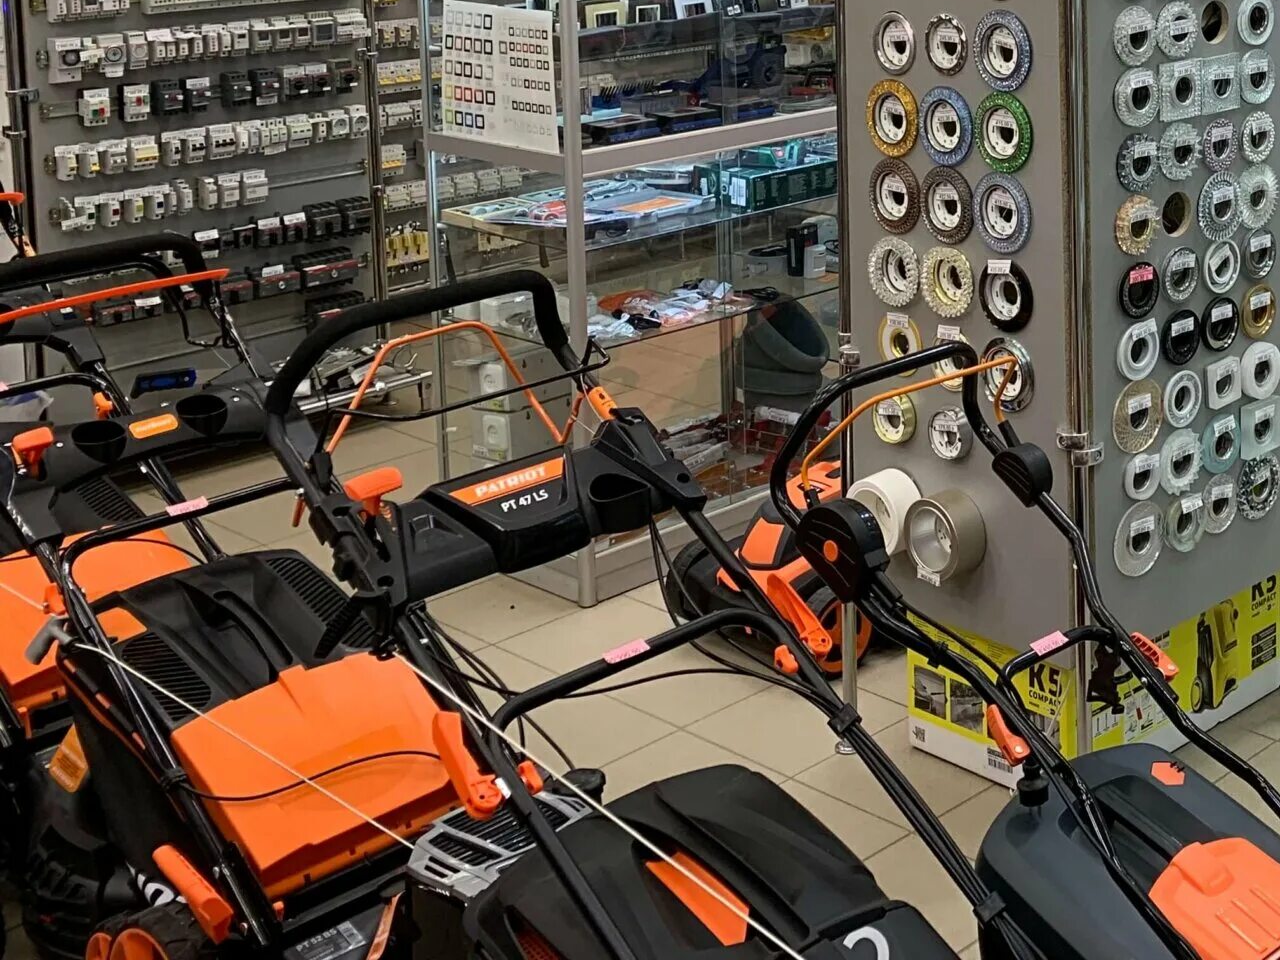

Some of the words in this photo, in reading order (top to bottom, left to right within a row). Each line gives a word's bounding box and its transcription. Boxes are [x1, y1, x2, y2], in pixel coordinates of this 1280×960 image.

[475, 466, 545, 497] PATRIOT
[500, 500, 517, 512] PT
[518, 494, 532, 506] 47
[532, 489, 549, 501] LS
[1251, 591, 1277, 611] COMPACT
[295, 942, 311, 952] PT
